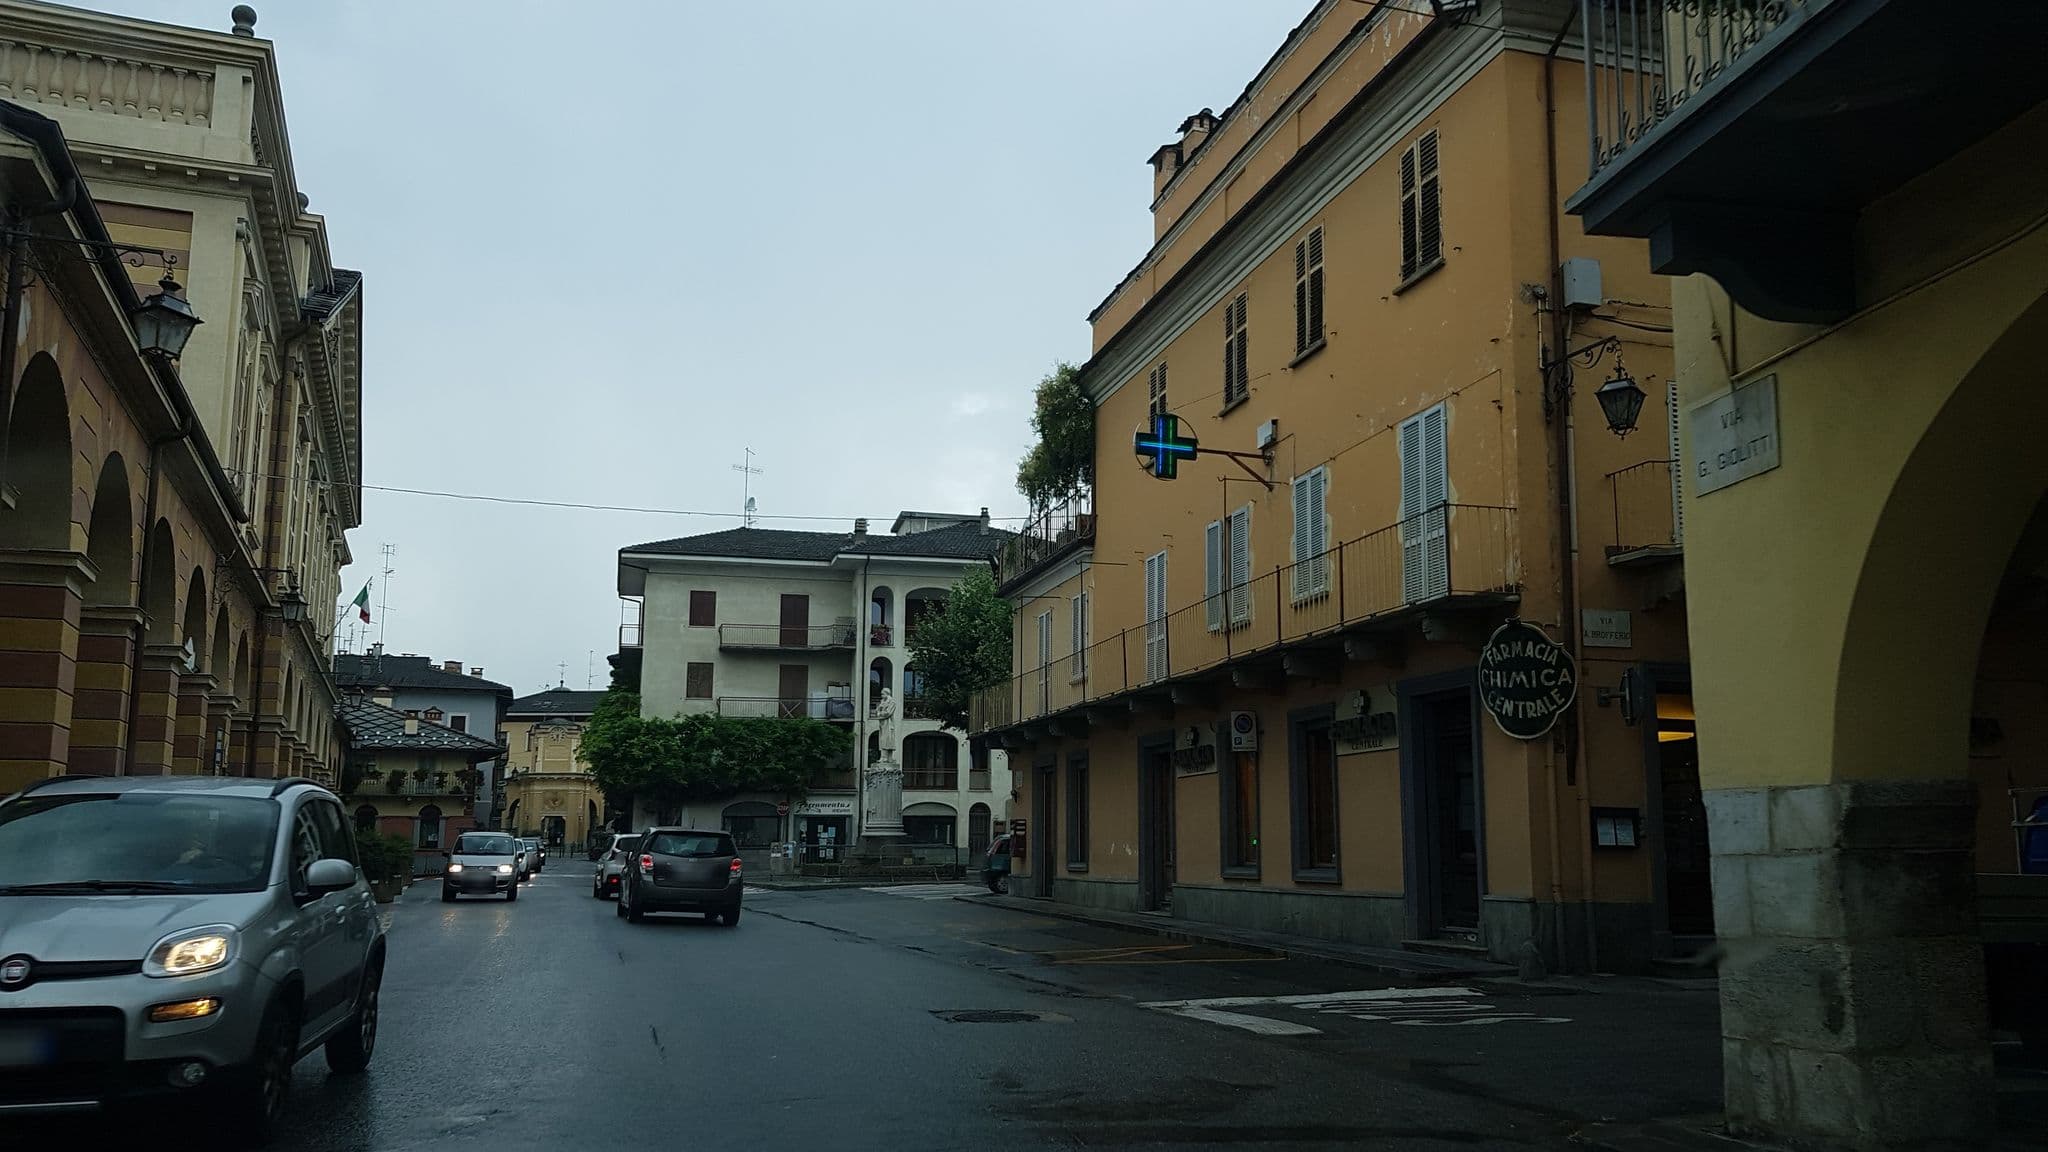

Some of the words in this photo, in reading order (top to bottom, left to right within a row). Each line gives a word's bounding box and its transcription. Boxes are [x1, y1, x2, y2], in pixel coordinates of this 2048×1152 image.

[1720, 408, 1744, 430] VIA
[1599, 617, 1614, 625] VIA
[1486, 640, 1559, 667] FARMACIA
[1481, 668, 1573, 689] CHIMICA
[1488, 688, 1565, 718] CENTRALE
